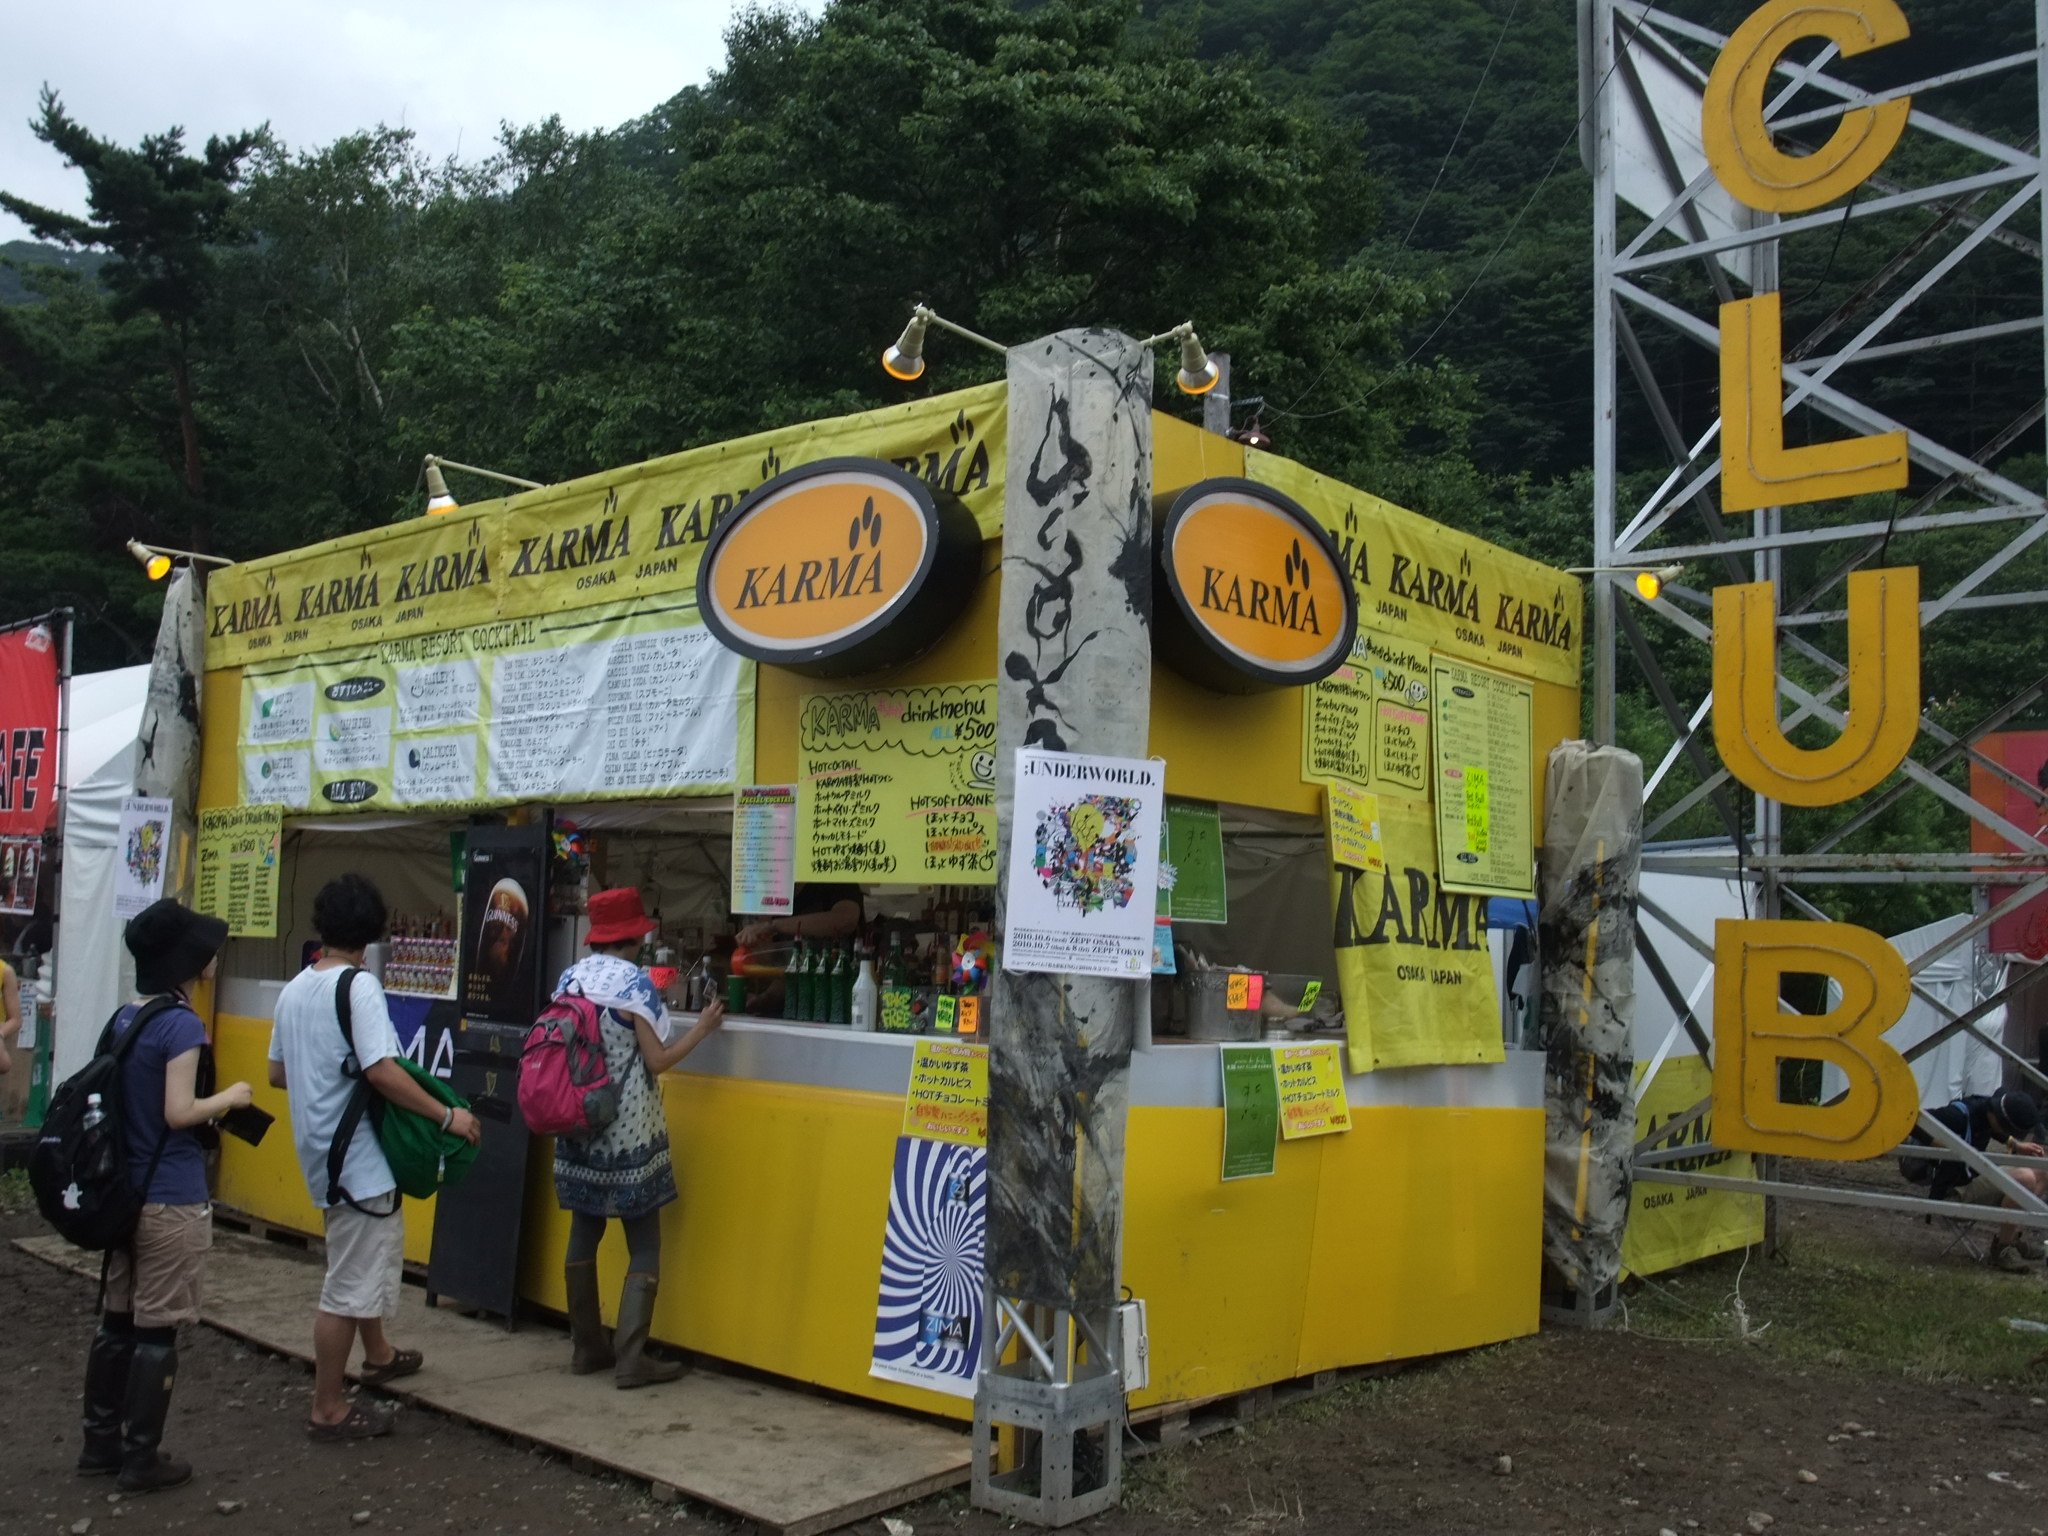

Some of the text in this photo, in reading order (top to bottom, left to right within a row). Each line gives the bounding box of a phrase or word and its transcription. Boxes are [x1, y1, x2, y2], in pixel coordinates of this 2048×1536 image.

[210, 592, 283, 638] KARMA
[294, 571, 380, 622] KARMA
[394, 545, 491, 603] KARMA
[508, 515, 631, 578] KARMA
[576, 557, 678, 590] OSAKA JAPAN
[733, 550, 884, 611] KARMA
[1702, 0, 1921, 1162] CLUB
[1200, 565, 1322, 636] KARMA
[1376, 599, 1408, 623] JAPAN
[1388, 553, 1481, 624] KARMA
[1495, 592, 1571, 652] KARMA
[351, 606, 424, 632] OSAKA JAPAN
[248, 629, 308, 650] OSAKA JAPAN
[381, 620, 536, 665] KARMA RESORT COCKTAIL
[1455, 627, 1523, 659] OSAKA JAPAN
[811, 699, 881, 742] KARMA
[954, 717, 995, 741] ¥500
[486, 908, 519, 934] GUINNESS
[1012, 940, 1051, 950] 2010.10.7
[1091, 946, 1114, 954] ZEPP
[1115, 948, 1145, 956] TOKYO
[1013, 931, 1051, 942] 2010.10.6
[1069, 936, 1092, 945] ZEPP
[1092, 938, 1121, 947] OSAKA
[1397, 964, 1426, 982] OSAKA
[1643, 1192, 1674, 1210] OSAKA
[925, 1315, 963, 1338] ZIMA
